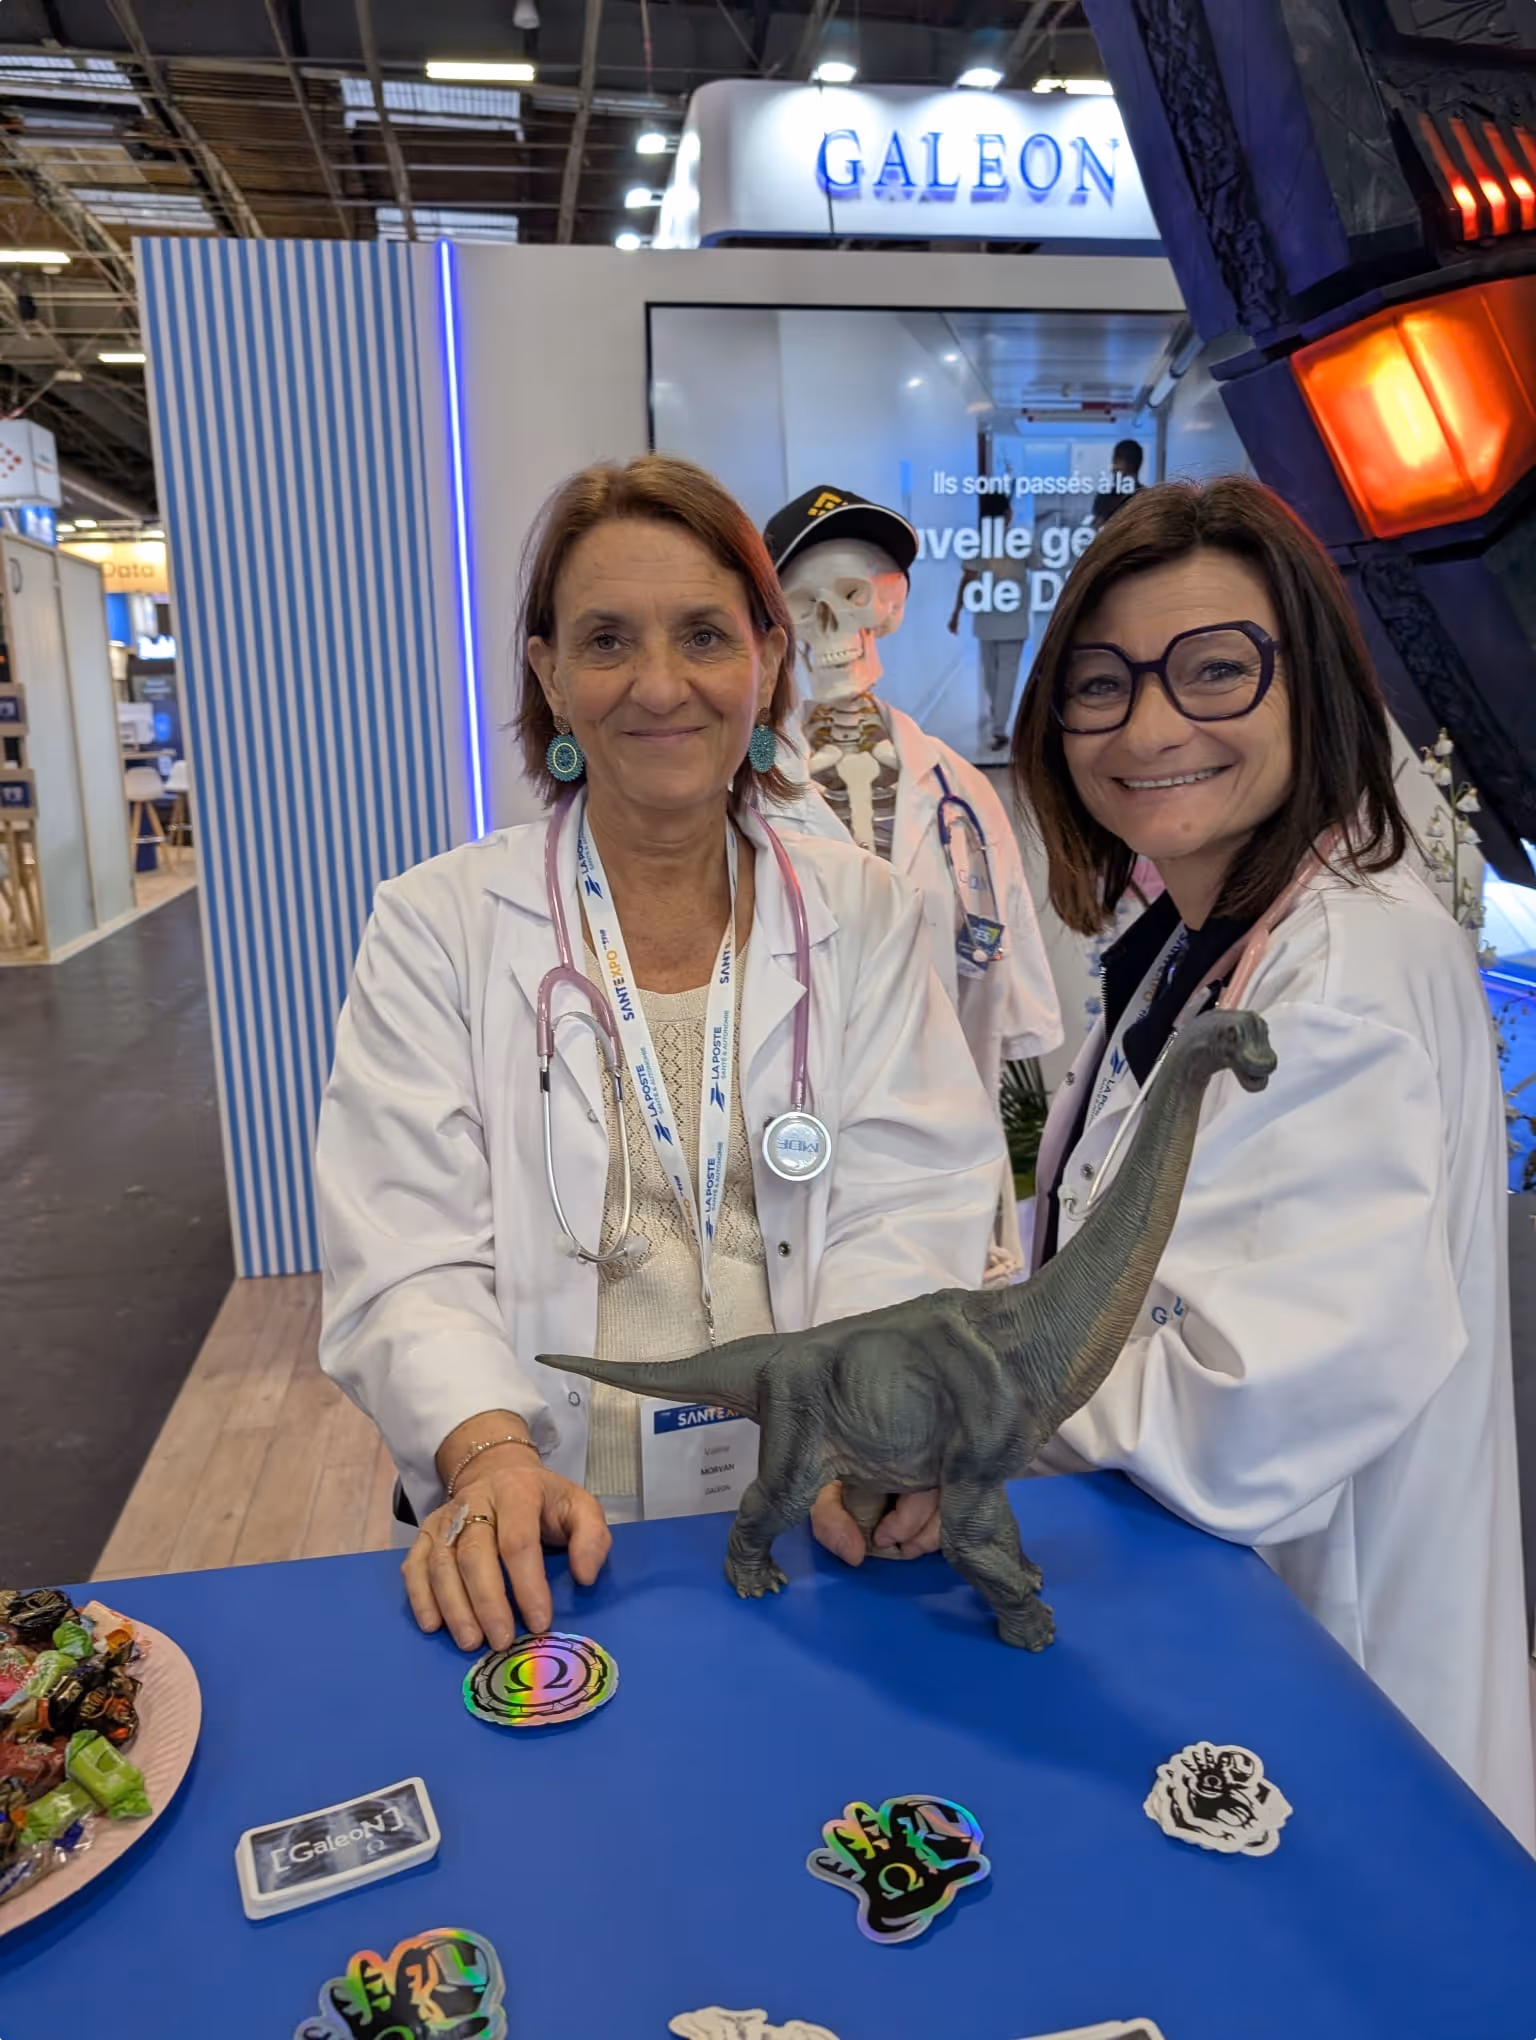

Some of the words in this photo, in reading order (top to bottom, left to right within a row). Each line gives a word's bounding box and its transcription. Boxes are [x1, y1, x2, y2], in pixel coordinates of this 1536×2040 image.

[816, 129, 1119, 202] GALEON
[933, 472, 957, 494] Ils
[962, 474, 1012, 494] sont
[1015, 472, 1093, 498] passés
[1097, 472, 1112, 494] à
[1116, 472, 1136, 494] la
[962, 571, 1021, 612] de
[606, 950, 635, 1022] SANTEXPO
[710, 1026, 723, 1062] POSTE
[635, 1064, 652, 1101] POSTE
[711, 1064, 720, 1079] LA
[1103, 1079, 1115, 1094] LA
[646, 1102, 657, 1117] LA
[778, 1139, 819, 1153] MDF
[703, 1157, 716, 1196] POSTE
[704, 1196, 711, 1212] LA
